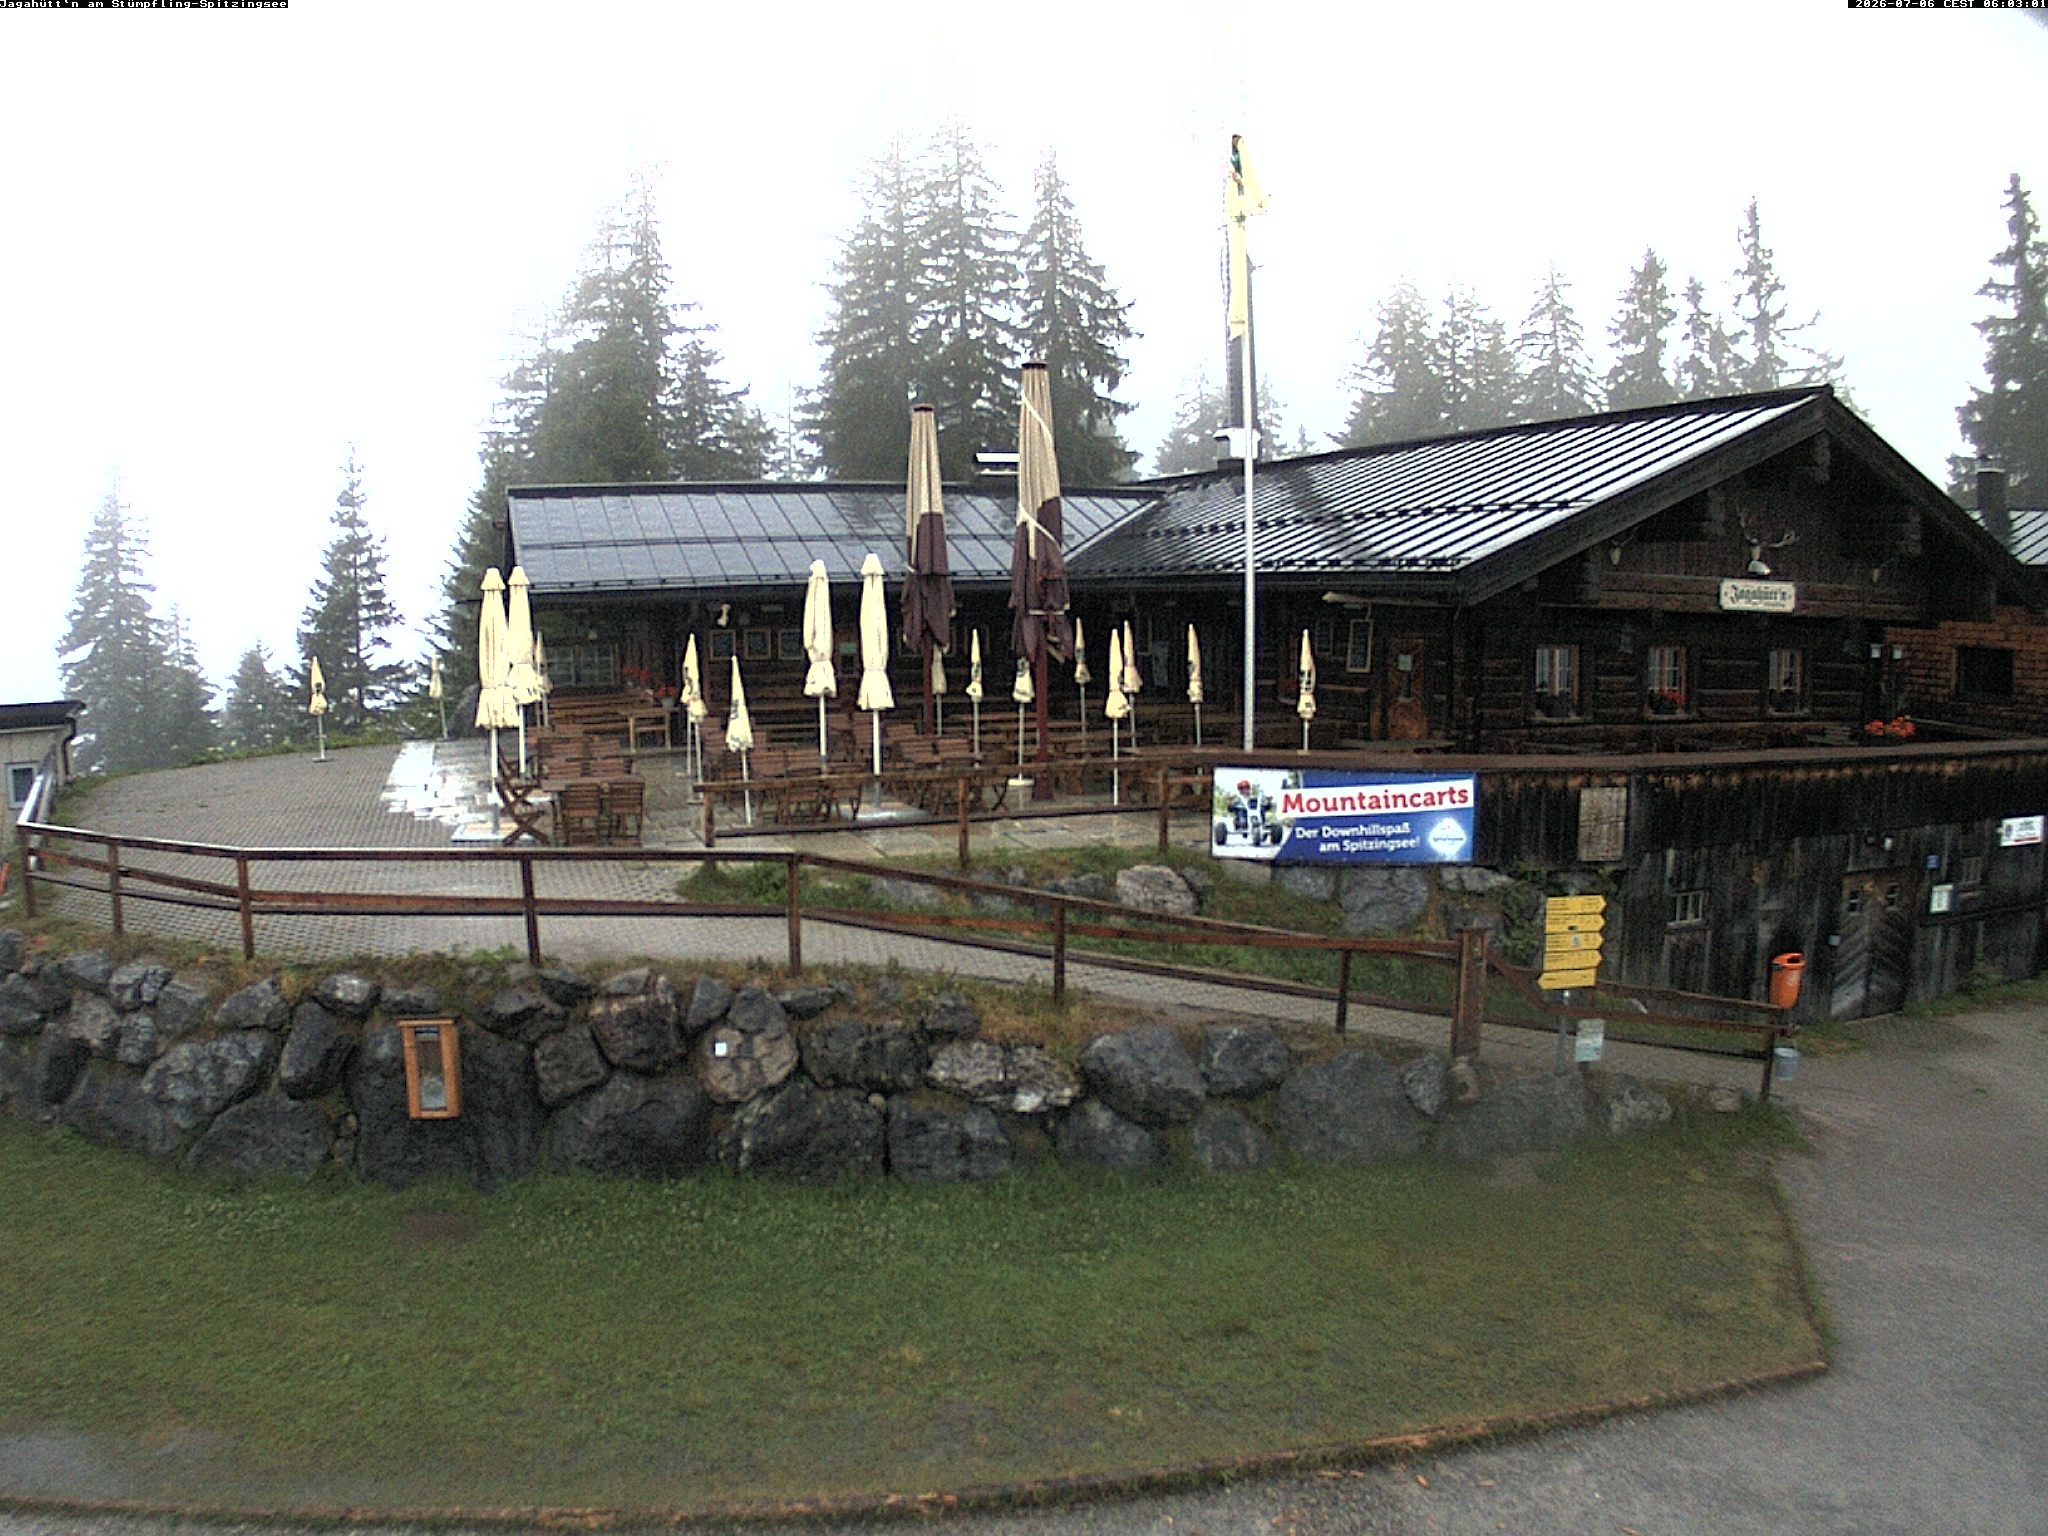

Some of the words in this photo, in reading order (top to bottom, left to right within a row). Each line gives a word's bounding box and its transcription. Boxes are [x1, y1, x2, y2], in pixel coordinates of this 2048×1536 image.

[1282, 786, 1469, 813] Mountaincarts
[1295, 827, 1319, 838] Der
[1321, 822, 1411, 838] Downhillspaß
[1319, 842, 1341, 853] am
[1342, 836, 1420, 853] Spitzingsee!
